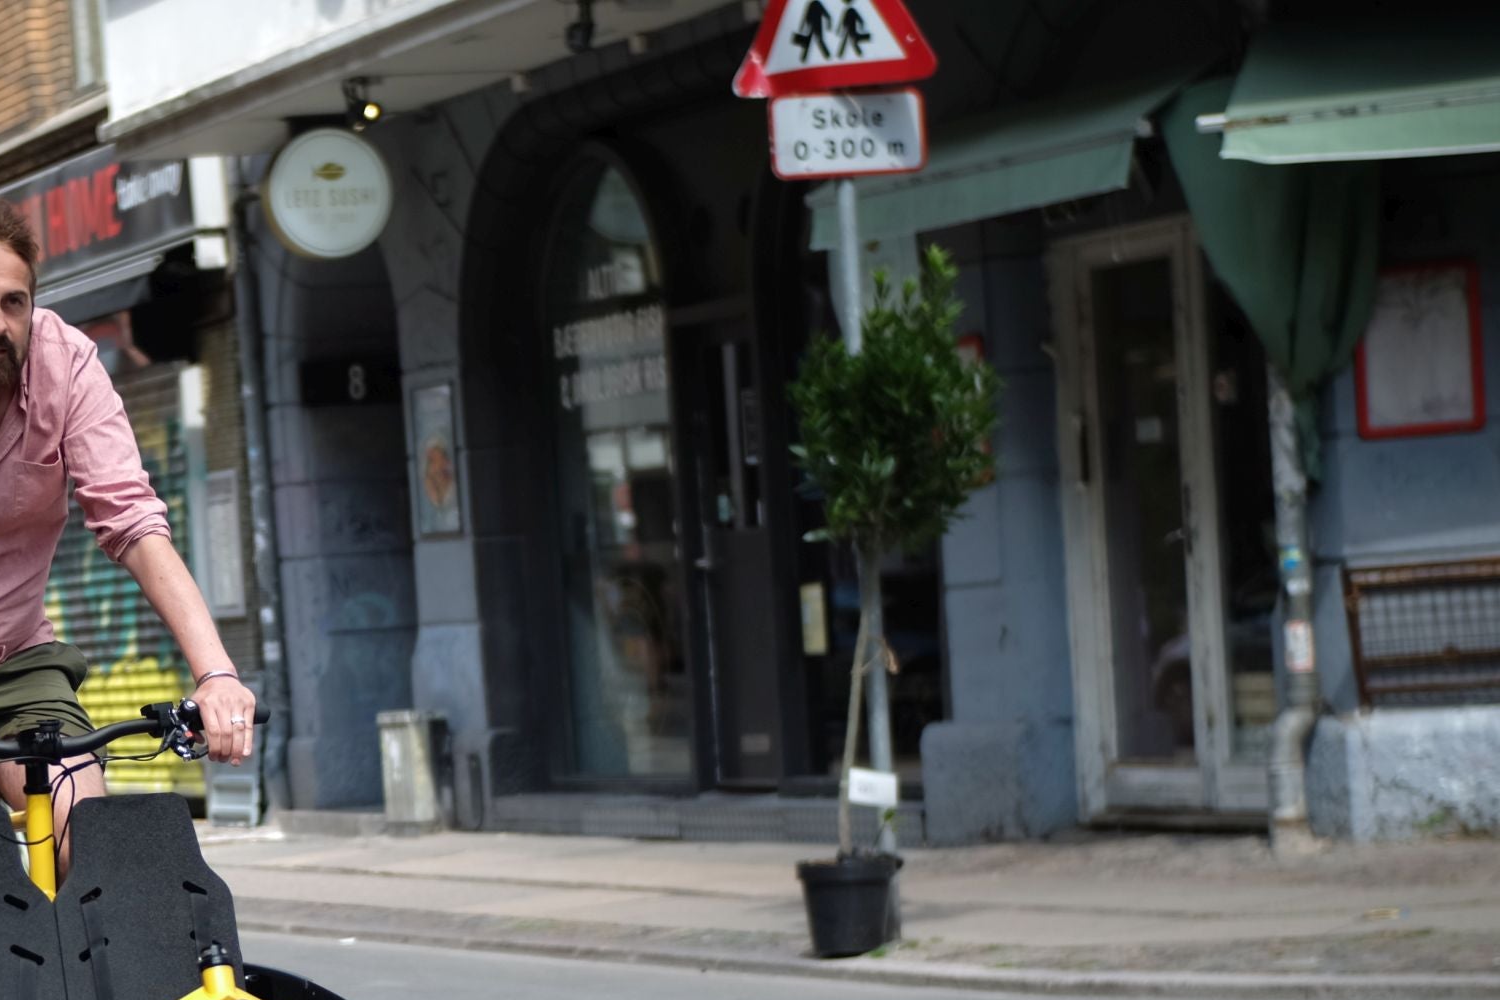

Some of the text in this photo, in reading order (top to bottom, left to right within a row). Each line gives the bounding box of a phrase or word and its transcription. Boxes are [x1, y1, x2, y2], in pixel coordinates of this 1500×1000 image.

[812, 108, 884, 129] Skole
[793, 138, 906, 161] 0-300 m
[348, 365, 367, 400] 8
